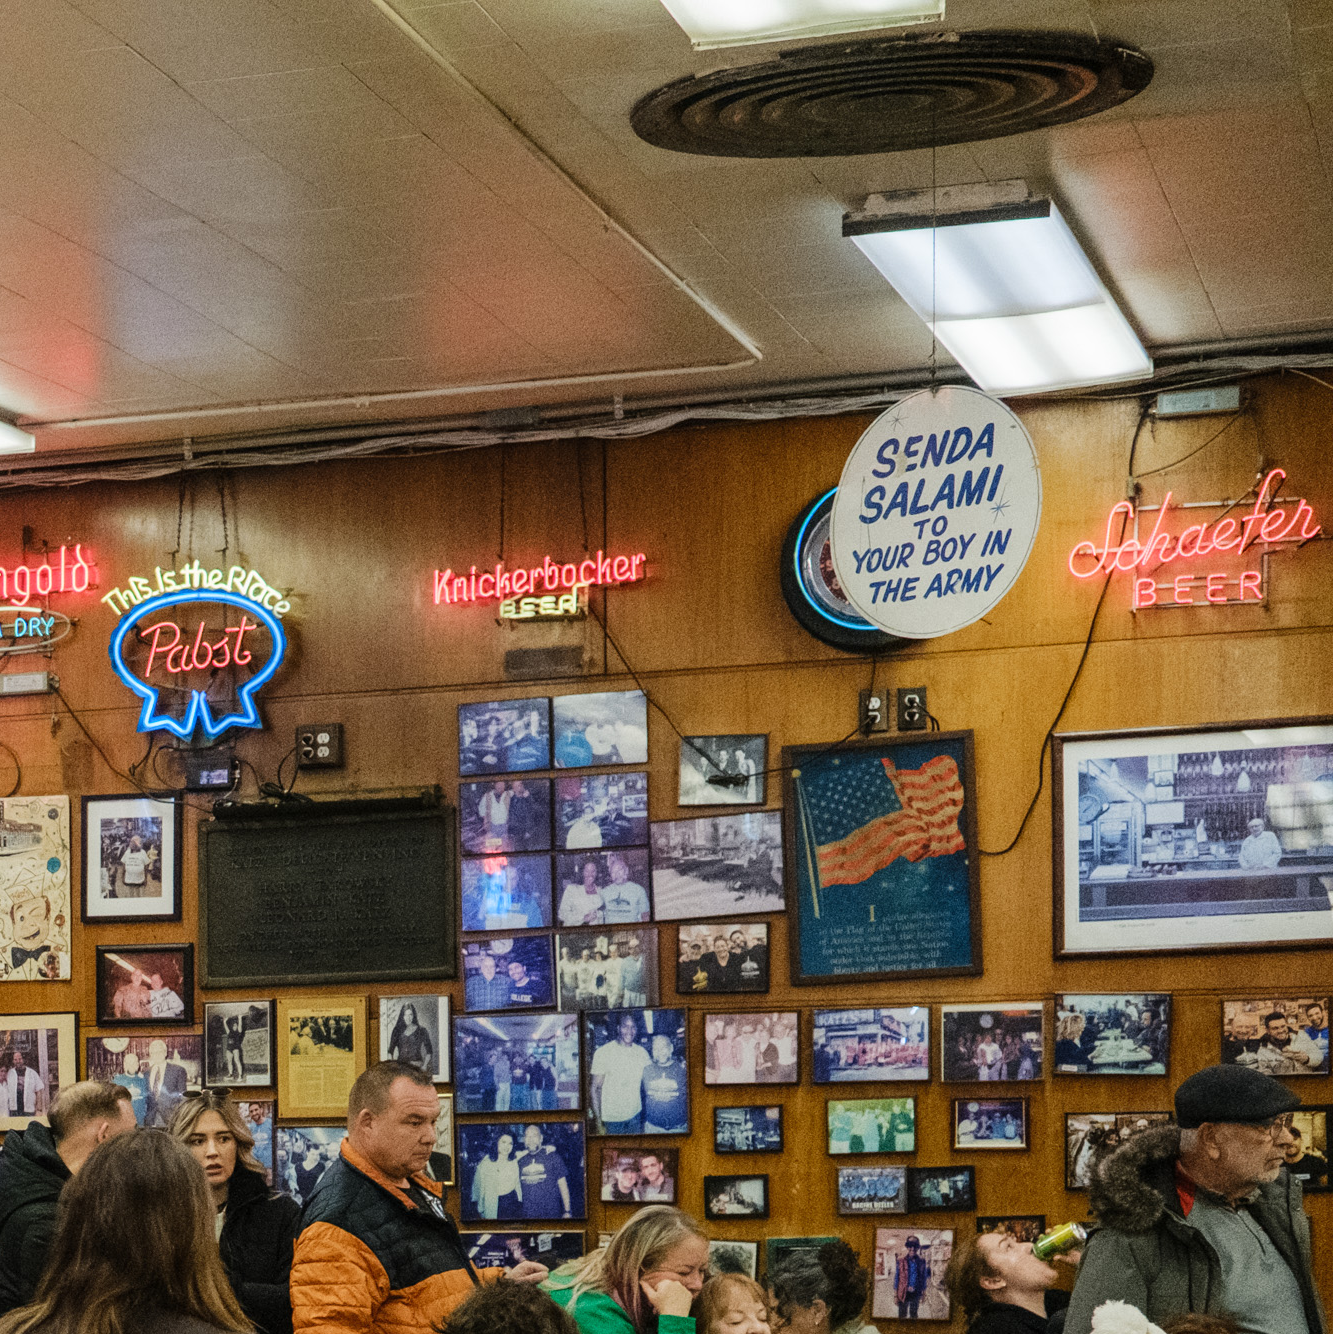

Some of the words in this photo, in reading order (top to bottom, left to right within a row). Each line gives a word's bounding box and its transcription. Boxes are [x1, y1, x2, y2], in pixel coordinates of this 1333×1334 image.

[871, 422, 995, 479] SENDA
[858, 464, 1004, 525] SALAMI
[913, 515, 949, 540] TO
[1068, 468, 1322, 580] Schaefer
[851, 540, 915, 575] YOUR
[922, 531, 976, 564] BOY
[981, 528, 1013, 555] IN
[101, 576, 149, 616] This
[179, 559, 224, 589] the
[432, 550, 647, 605] Knickerbocker
[869, 577, 922, 605] THE
[922, 563, 1005, 598] ARMY
[1135, 571, 1264, 608] BEER
[499, 586, 578, 620] BEER
[14, 616, 56, 638] DRY
[140, 616, 258, 678] Pabst
[869, 904, 877, 922] I
